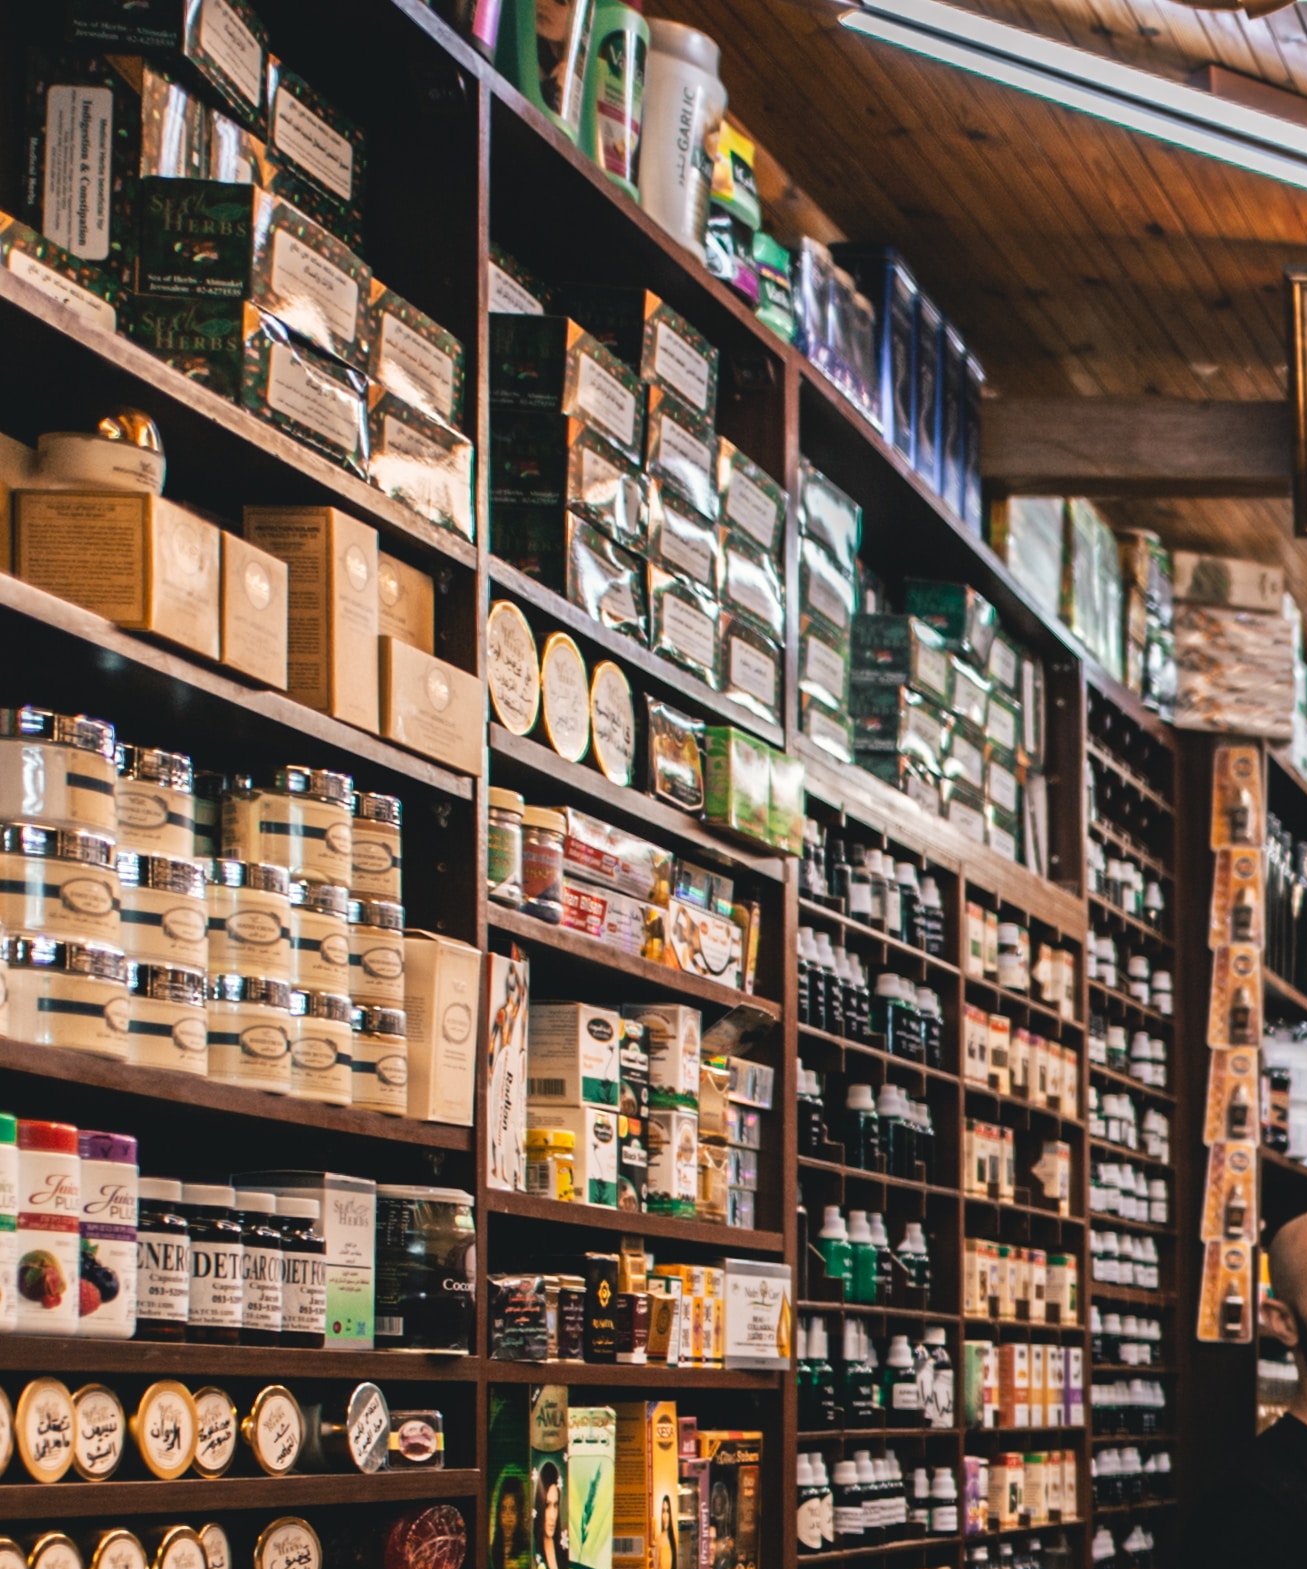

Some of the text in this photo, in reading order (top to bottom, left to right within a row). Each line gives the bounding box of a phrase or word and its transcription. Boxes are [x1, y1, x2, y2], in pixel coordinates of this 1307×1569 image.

[81, 101, 92, 160] Indigestion
[677, 87, 696, 152] GARLIC
[78, 176, 90, 246] Constipation
[163, 210, 247, 237] HERBS
[502, 1072, 514, 1132] Radian
[84, 1184, 137, 1214] Juice
[536, 1405, 567, 1430] AMLA
[656, 1424, 675, 1439] SESA
